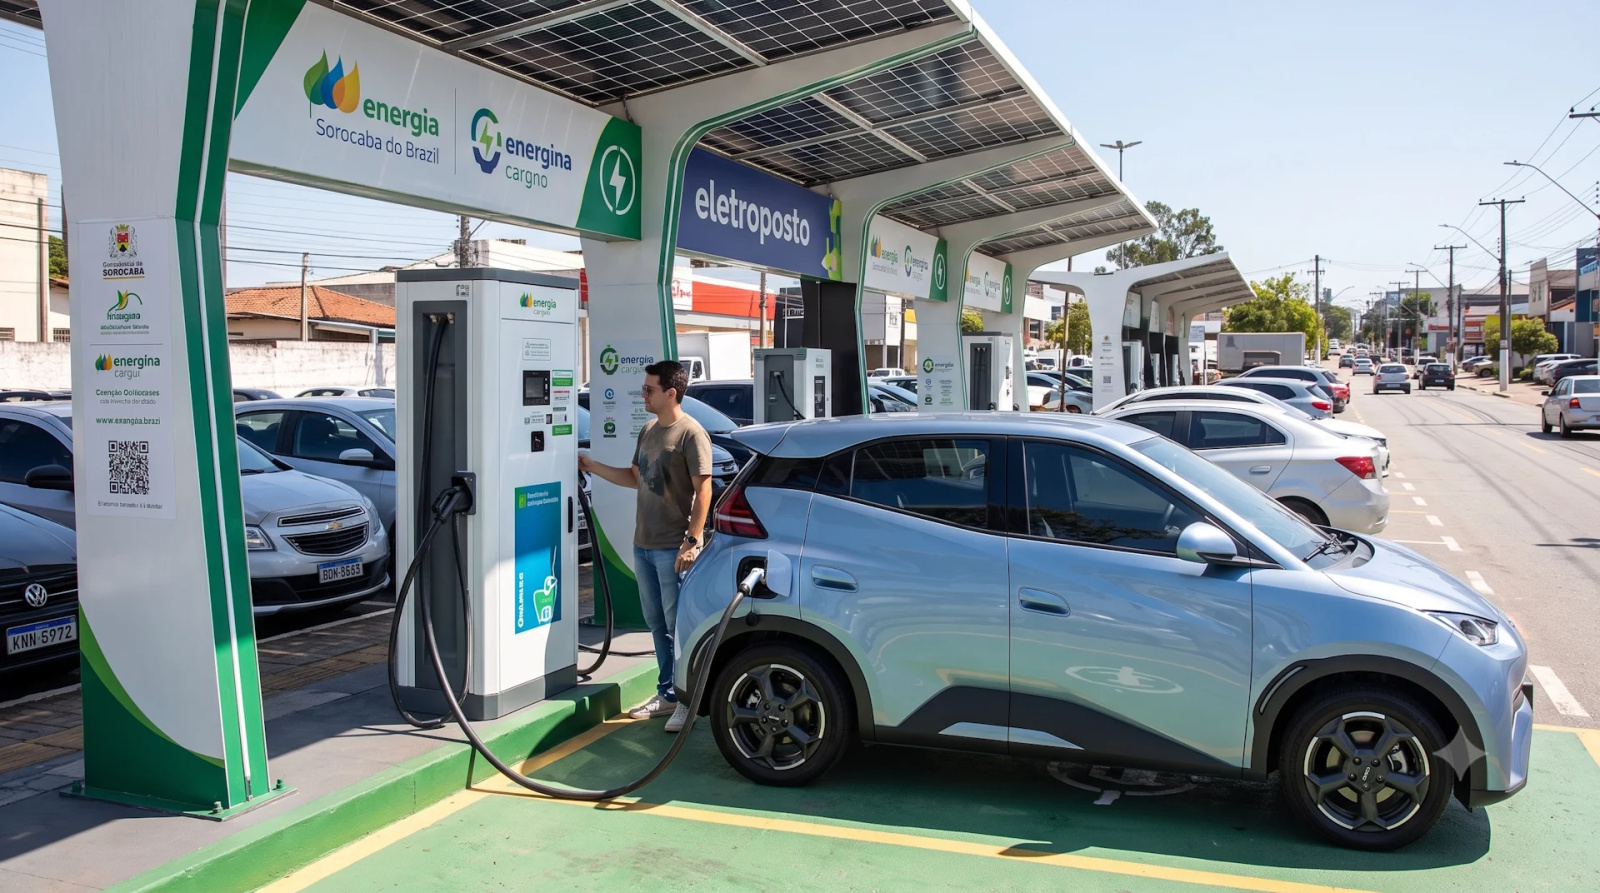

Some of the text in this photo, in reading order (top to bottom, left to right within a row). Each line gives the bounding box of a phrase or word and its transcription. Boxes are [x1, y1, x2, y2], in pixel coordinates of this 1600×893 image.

[363, 98, 439, 137] energia
[316, 118, 439, 164] Sorocaba do Brazil
[505, 137, 572, 171] energina
[505, 165, 548, 189] cargno
[695, 179, 810, 246] eletroposto
[102, 267, 145, 276] SOROCABA
[13, 625, 73, 651] KNN 5972
